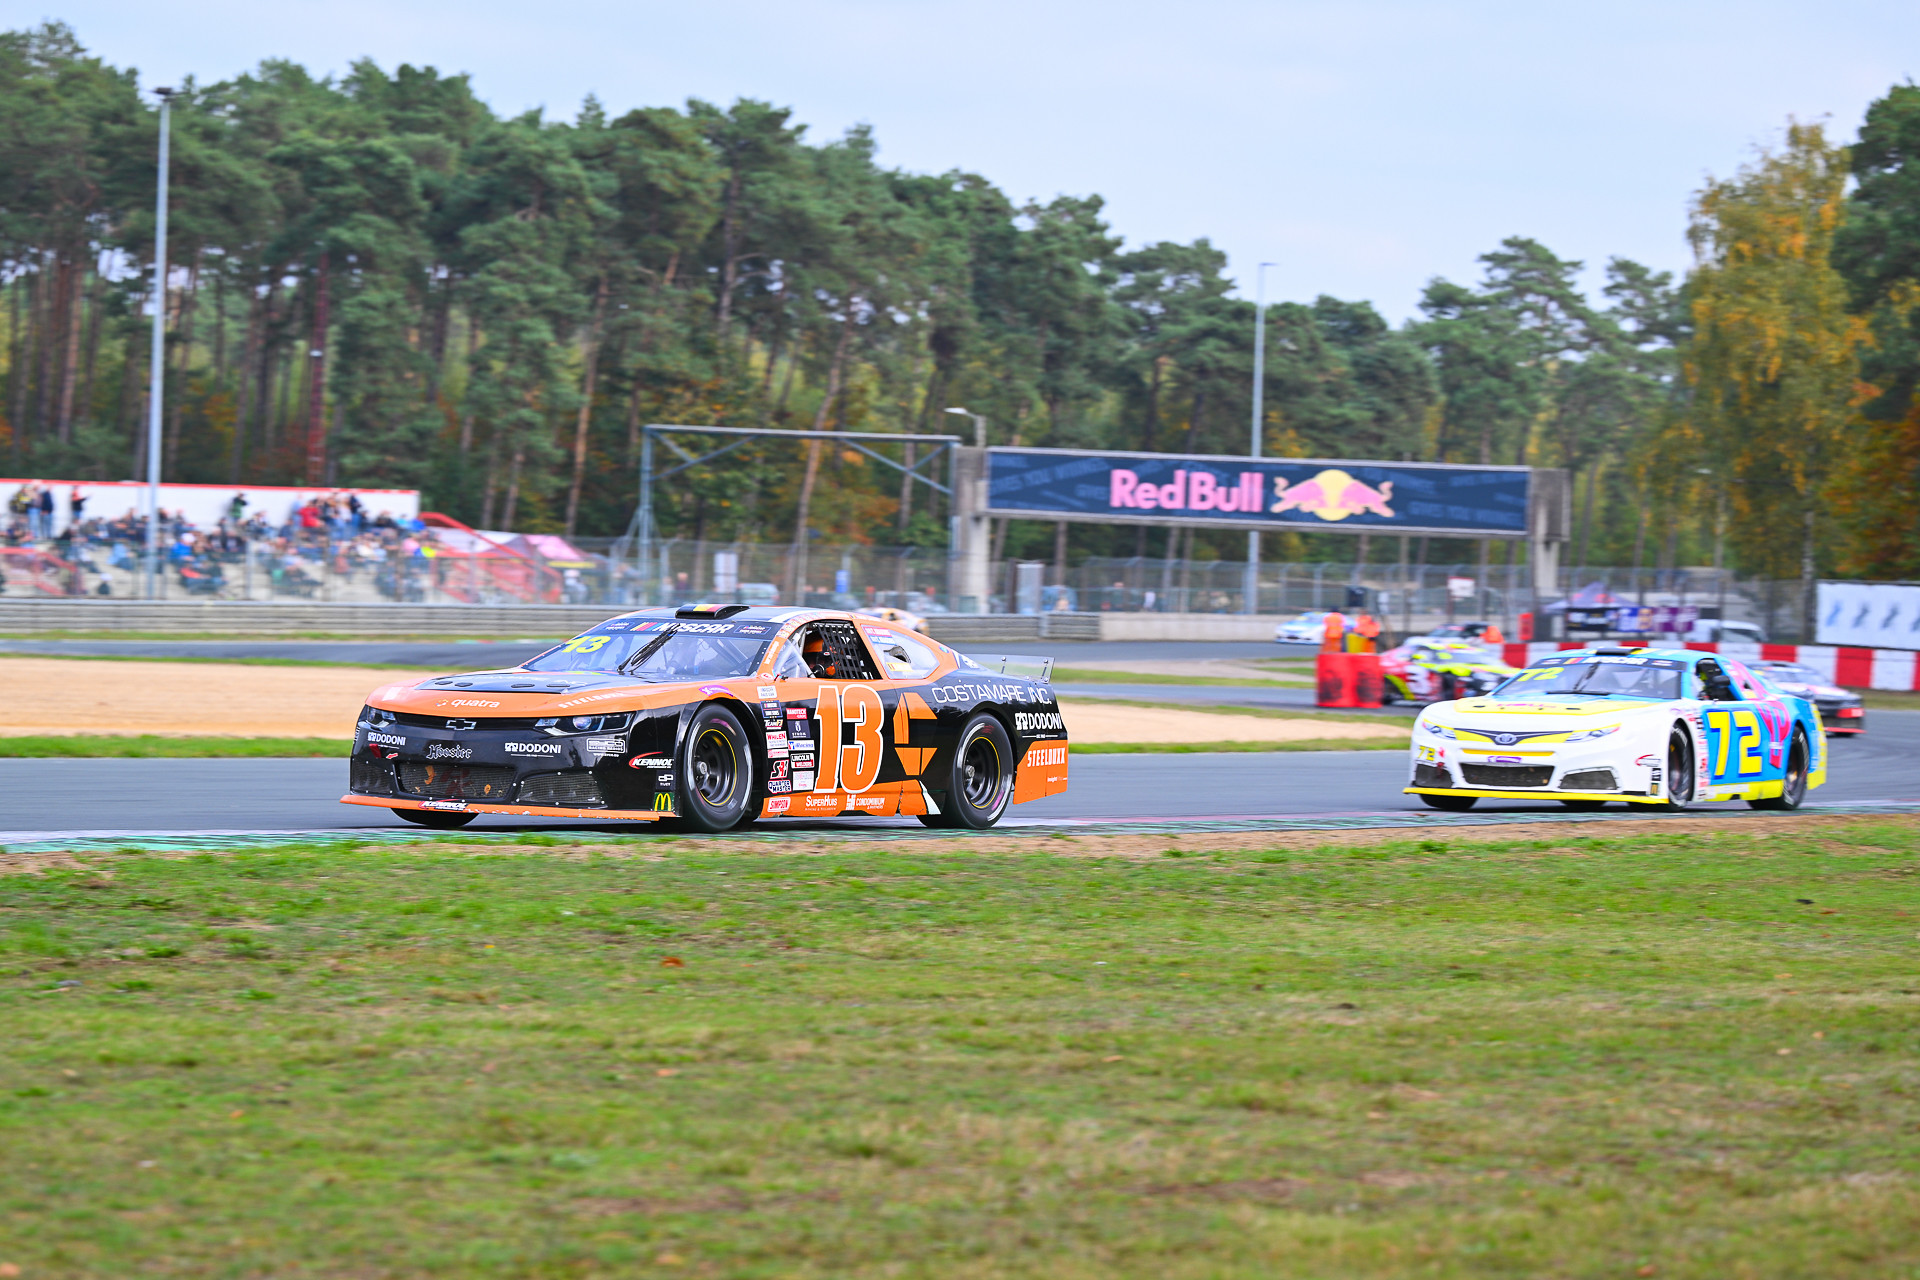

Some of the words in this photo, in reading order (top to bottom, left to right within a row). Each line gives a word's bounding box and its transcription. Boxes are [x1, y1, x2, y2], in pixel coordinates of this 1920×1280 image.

[1110, 468, 1186, 508] Red
[1189, 470, 1263, 512] Bull
[651, 622, 735, 635] NASCAR
[561, 635, 612, 654] 13
[1404, 664, 1432, 695] 3
[1516, 666, 1564, 682] 72
[931, 684, 1026, 704] COSTAMARE
[1027, 686, 1052, 705] INC.
[450, 697, 501, 709] quatra
[1028, 713, 1063, 730] DODONI
[376, 733, 407, 746] DODONI
[518, 741, 562, 754] DODONI
[814, 684, 886, 795] 13
[1706, 709, 1763, 778] 72
[425, 743, 473, 760] Hoosier
[791, 754, 810, 762] LINCOLN
[1027, 747, 1066, 768] STEELDUXX
[1417, 745, 1437, 762] 72
[631, 758, 673, 766] KENNOL
[768, 780, 790, 789] QUARTER
[772, 786, 790, 796] MASTER
[421, 801, 468, 810] KENNOL
[769, 799, 789, 810] SIMPSON
